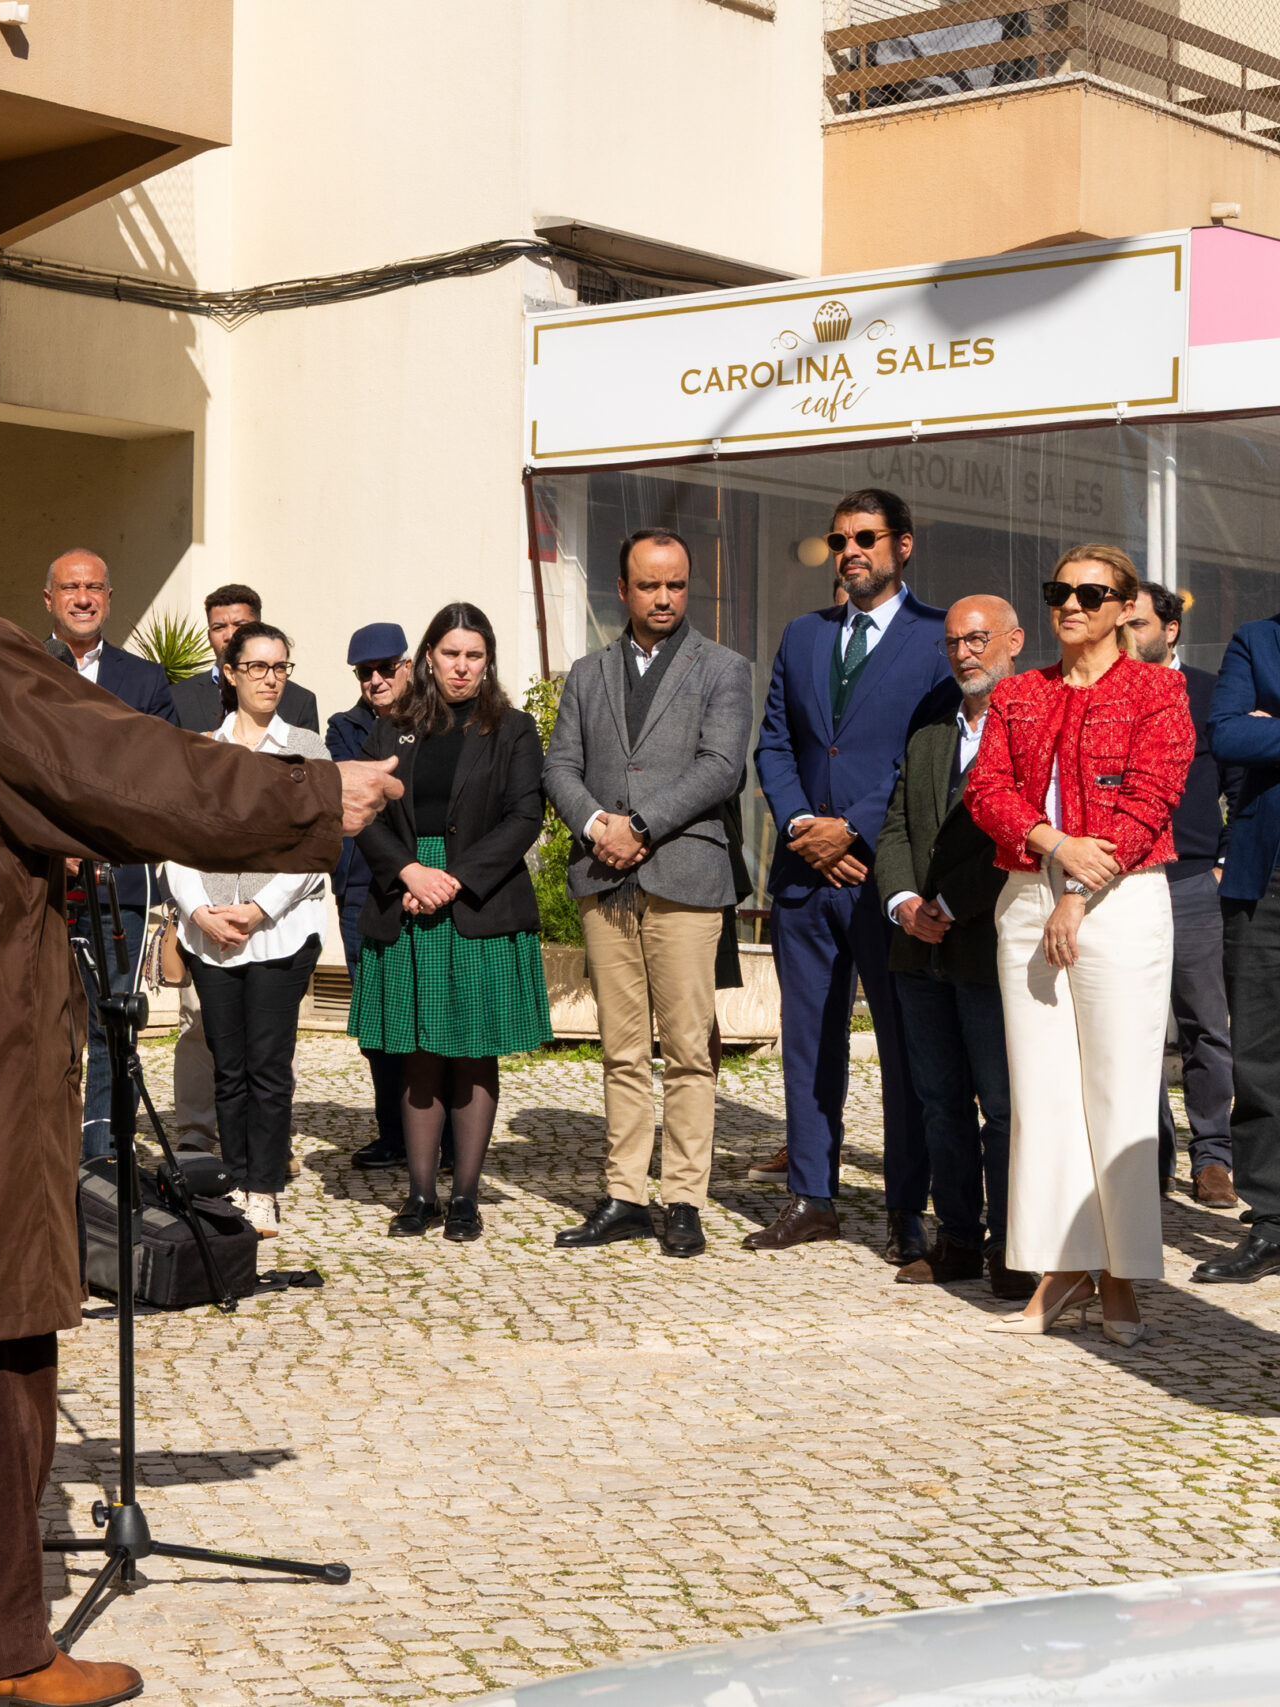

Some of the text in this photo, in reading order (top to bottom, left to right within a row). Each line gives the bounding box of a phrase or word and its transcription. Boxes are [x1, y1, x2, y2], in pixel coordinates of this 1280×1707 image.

[680, 337, 995, 396] CAROLINA SALES
[791, 379, 870, 423] café
[867, 448, 1006, 501] CAROLINA
